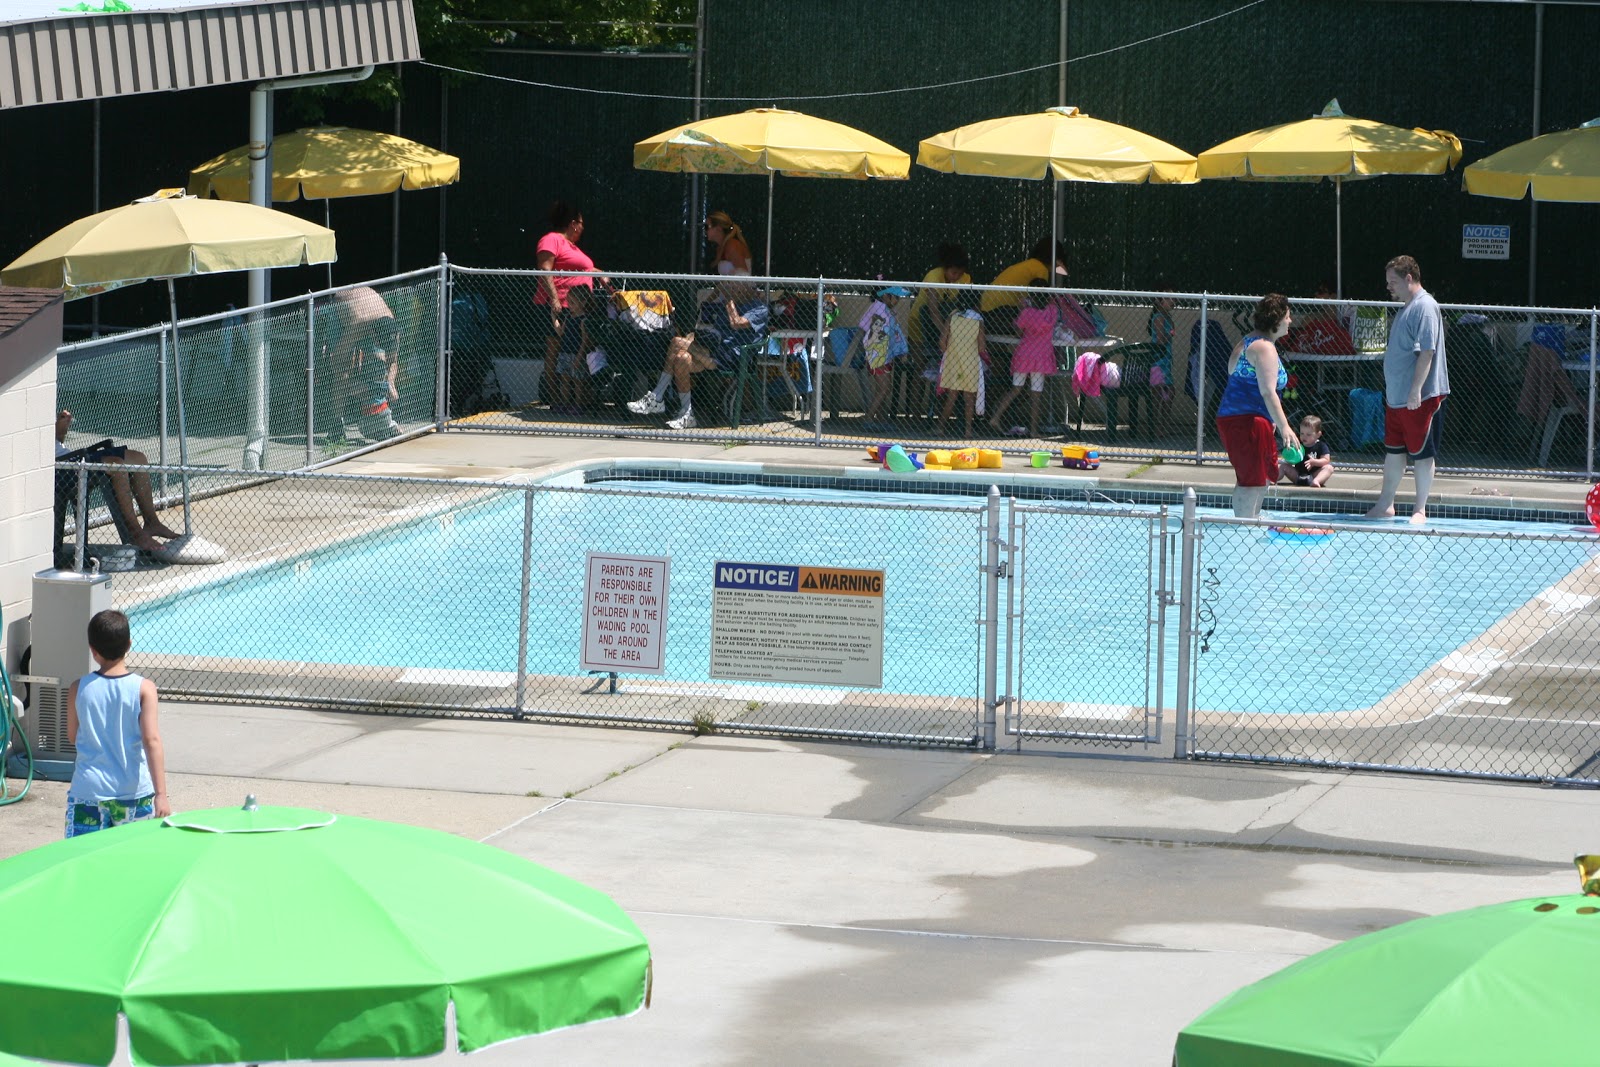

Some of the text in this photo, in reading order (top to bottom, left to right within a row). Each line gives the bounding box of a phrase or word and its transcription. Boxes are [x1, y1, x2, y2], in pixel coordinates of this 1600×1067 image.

[1466, 227, 1507, 237] NOTICE
[1355, 327, 1384, 339] CAKES
[602, 565, 653, 578] PARENTS ARE
[601, 579, 652, 592] RESPONSIBLE
[819, 573, 880, 592] WARNING
[595, 592, 656, 606] FOR THEIR OWN
[592, 606, 657, 620] CHILDREN IN THE
[598, 620, 650, 633] WADING POOL
[598, 635, 647, 647] AND AROUND
[604, 649, 640, 661] THE AREA
